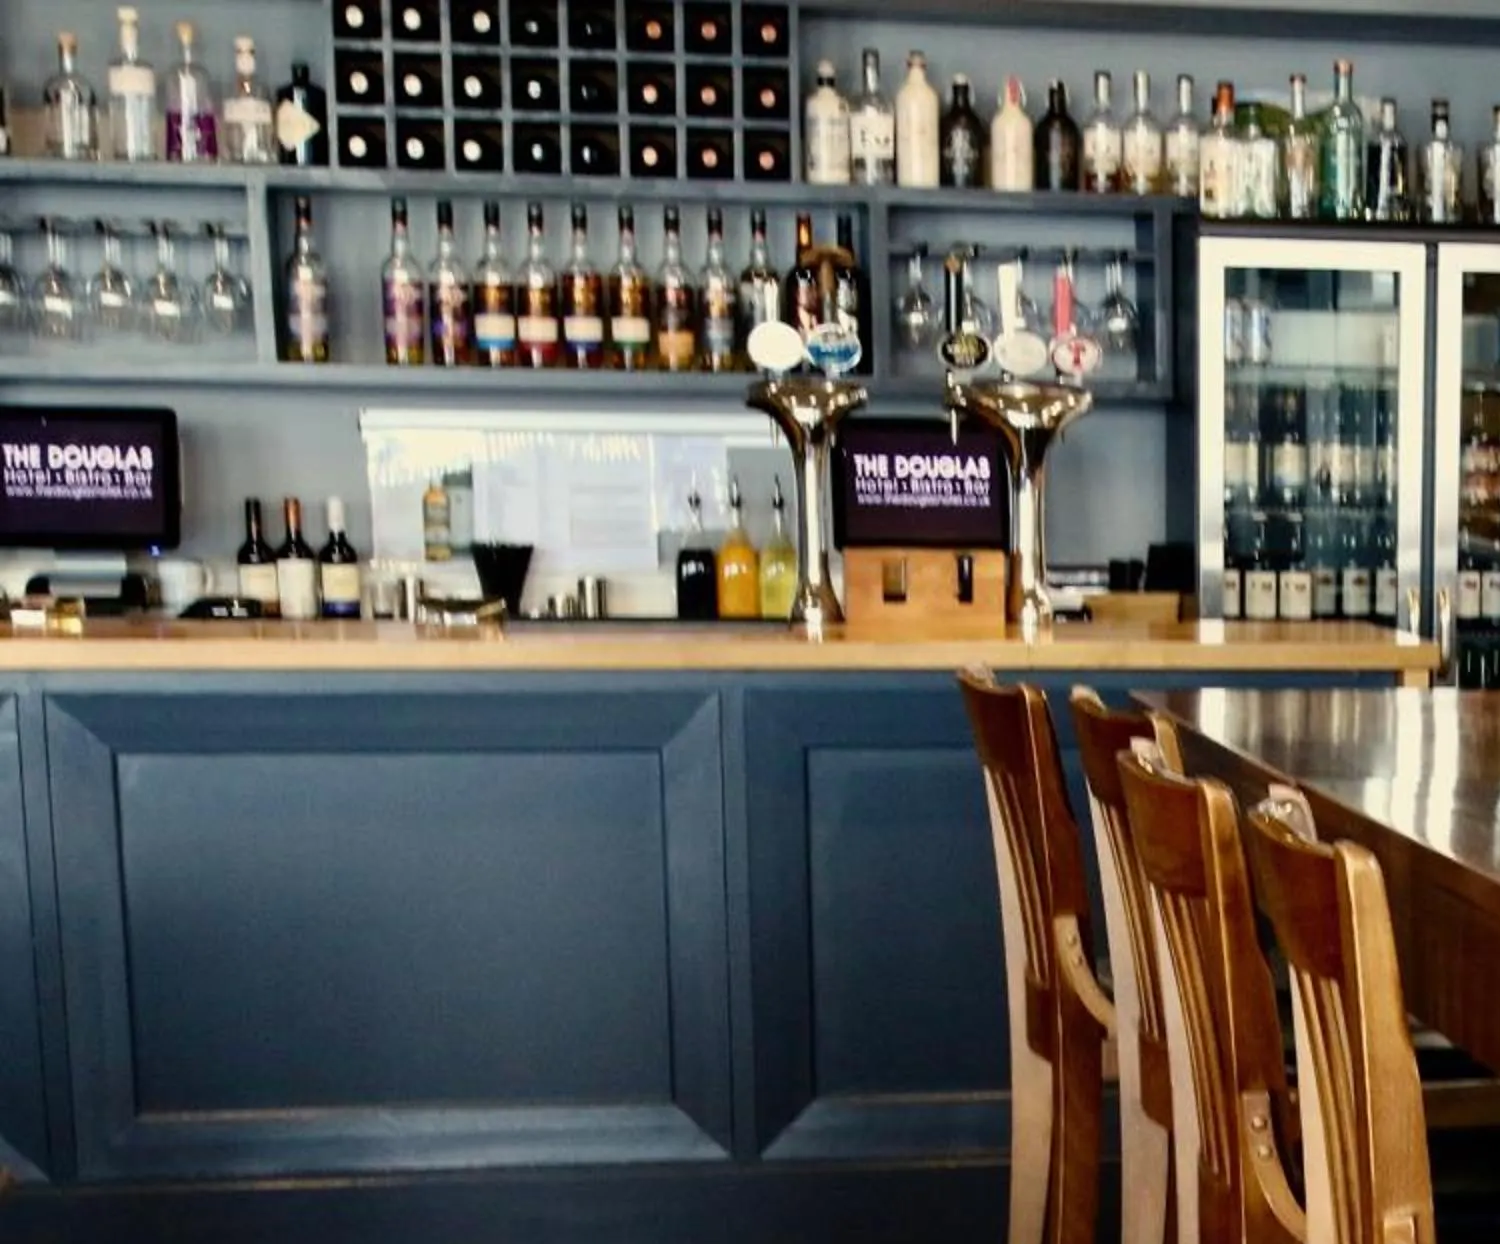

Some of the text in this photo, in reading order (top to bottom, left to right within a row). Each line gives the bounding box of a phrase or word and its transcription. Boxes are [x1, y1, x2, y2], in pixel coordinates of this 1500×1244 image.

[2, 443, 153, 471] THE DOUGLAS
[853, 453, 991, 480] THE DOUGLAS
